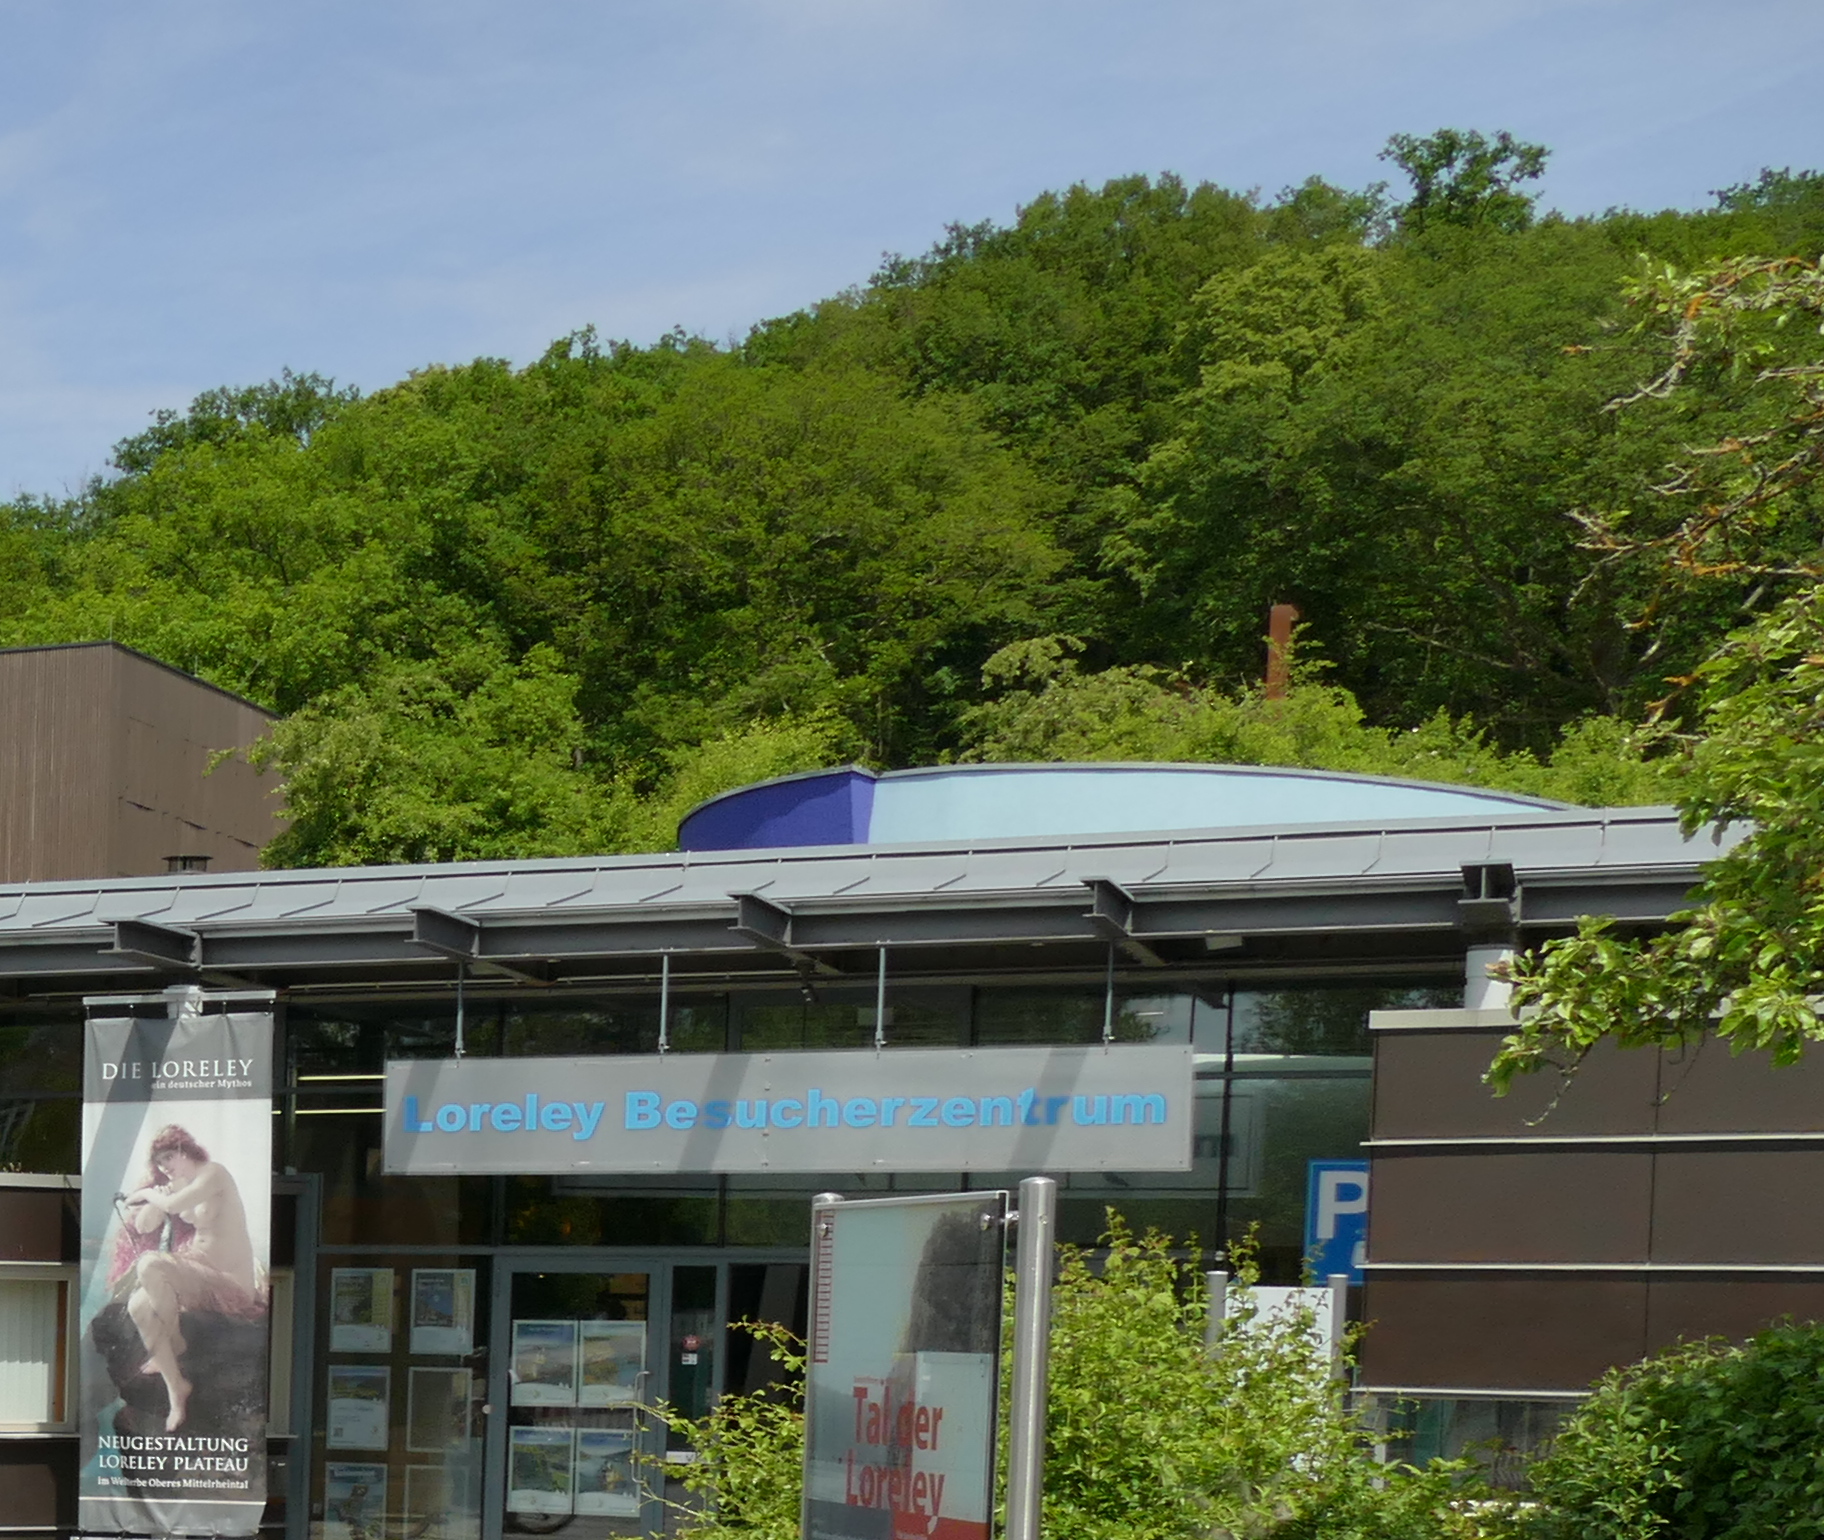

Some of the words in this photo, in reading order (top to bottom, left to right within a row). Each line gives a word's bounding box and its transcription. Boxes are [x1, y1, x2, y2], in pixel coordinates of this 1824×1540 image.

[102, 1062, 141, 1080] DIE
[152, 1059, 254, 1079] LORELEY
[167, 1080, 216, 1090] deutscher
[217, 1080, 252, 1090] Mythos
[402, 1093, 605, 1141] Loreley
[624, 1087, 1167, 1131] Besucherzentrum
[1317, 1170, 1369, 1239] P
[853, 1385, 892, 1446] Tal
[896, 1388, 944, 1451] der
[98, 1435, 249, 1452] NEUGESTALTUNG
[99, 1454, 168, 1471] LORELEY
[174, 1456, 249, 1472] PLATEAU
[148, 1477, 182, 1489] Oberes
[182, 1478, 250, 1490] Mittelrheintal
[845, 1448, 946, 1535] Loreley
